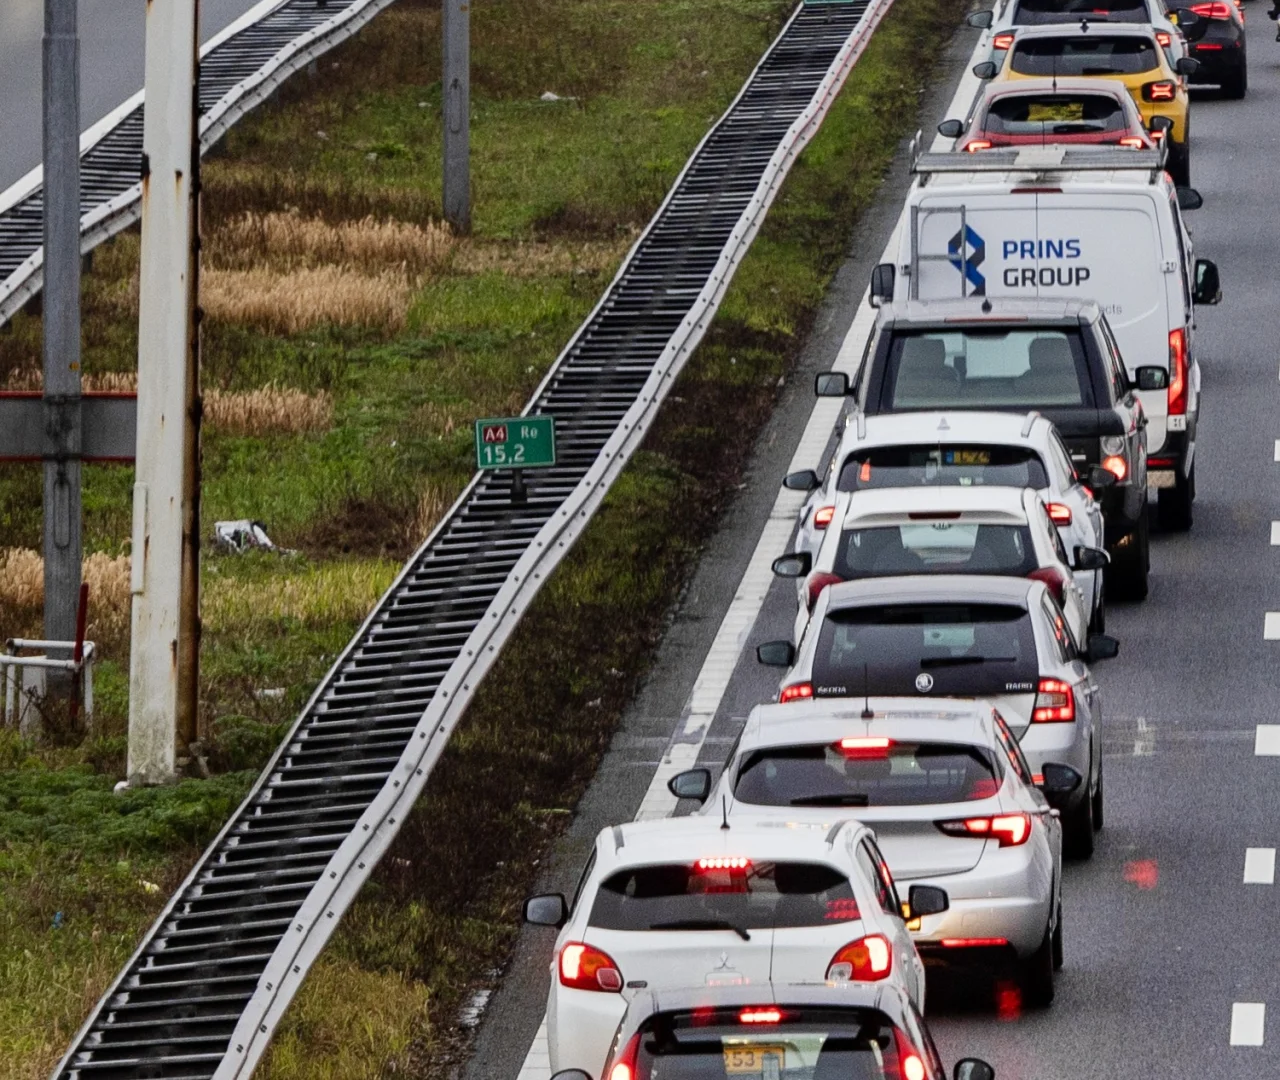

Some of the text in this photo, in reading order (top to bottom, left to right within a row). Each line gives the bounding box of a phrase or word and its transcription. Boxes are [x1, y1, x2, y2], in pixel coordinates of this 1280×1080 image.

[1003, 239, 1081, 260] PRINS
[1003, 267, 1091, 288] GROUP
[486, 425, 538, 442] A4 Re
[484, 444, 525, 465] 15,2
